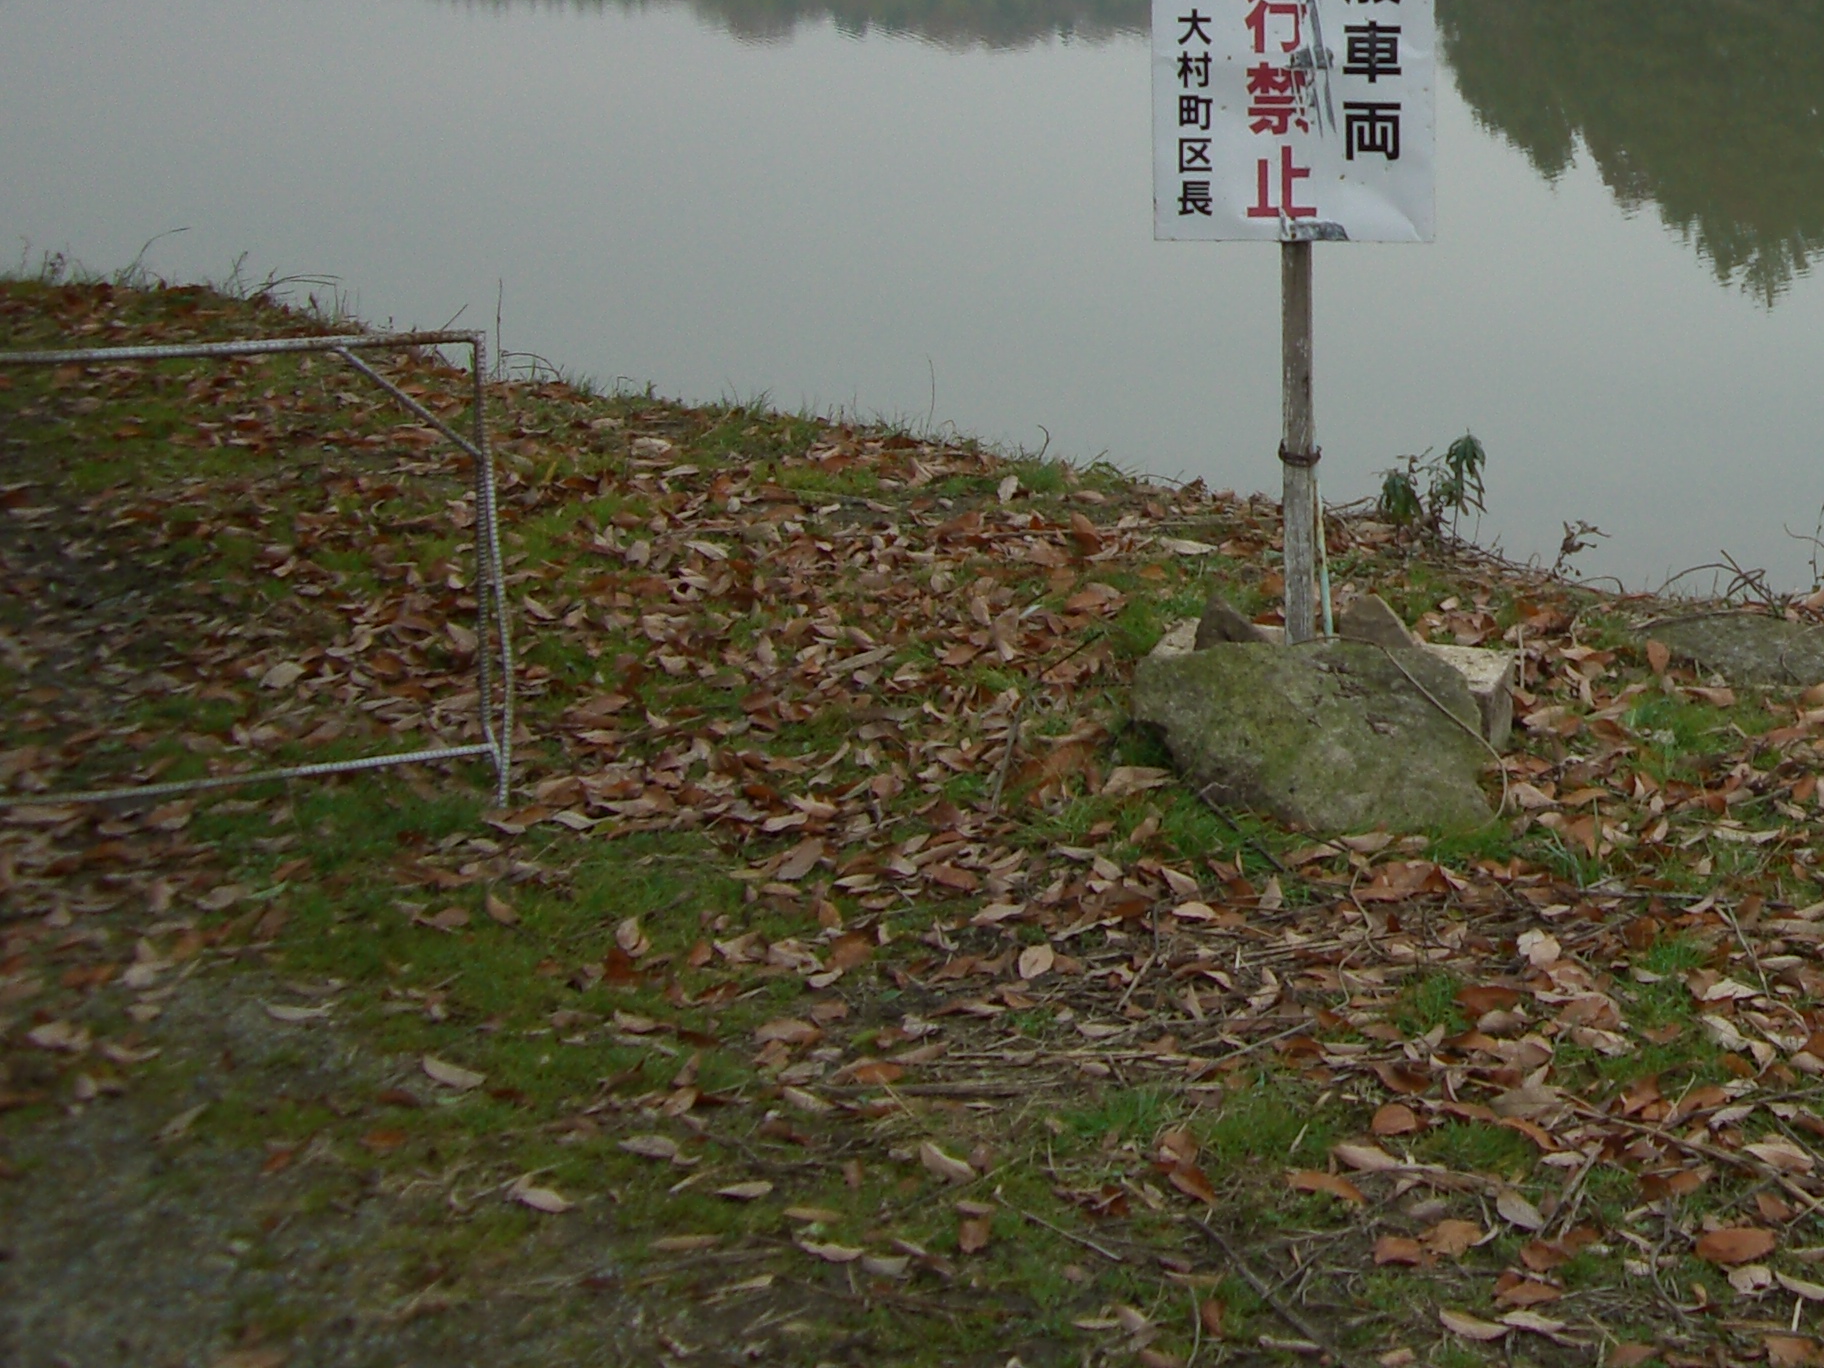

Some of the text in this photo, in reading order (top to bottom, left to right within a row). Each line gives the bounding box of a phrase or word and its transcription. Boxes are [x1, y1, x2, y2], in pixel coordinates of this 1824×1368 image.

[1177, 9, 1213, 217] 大村町区長
